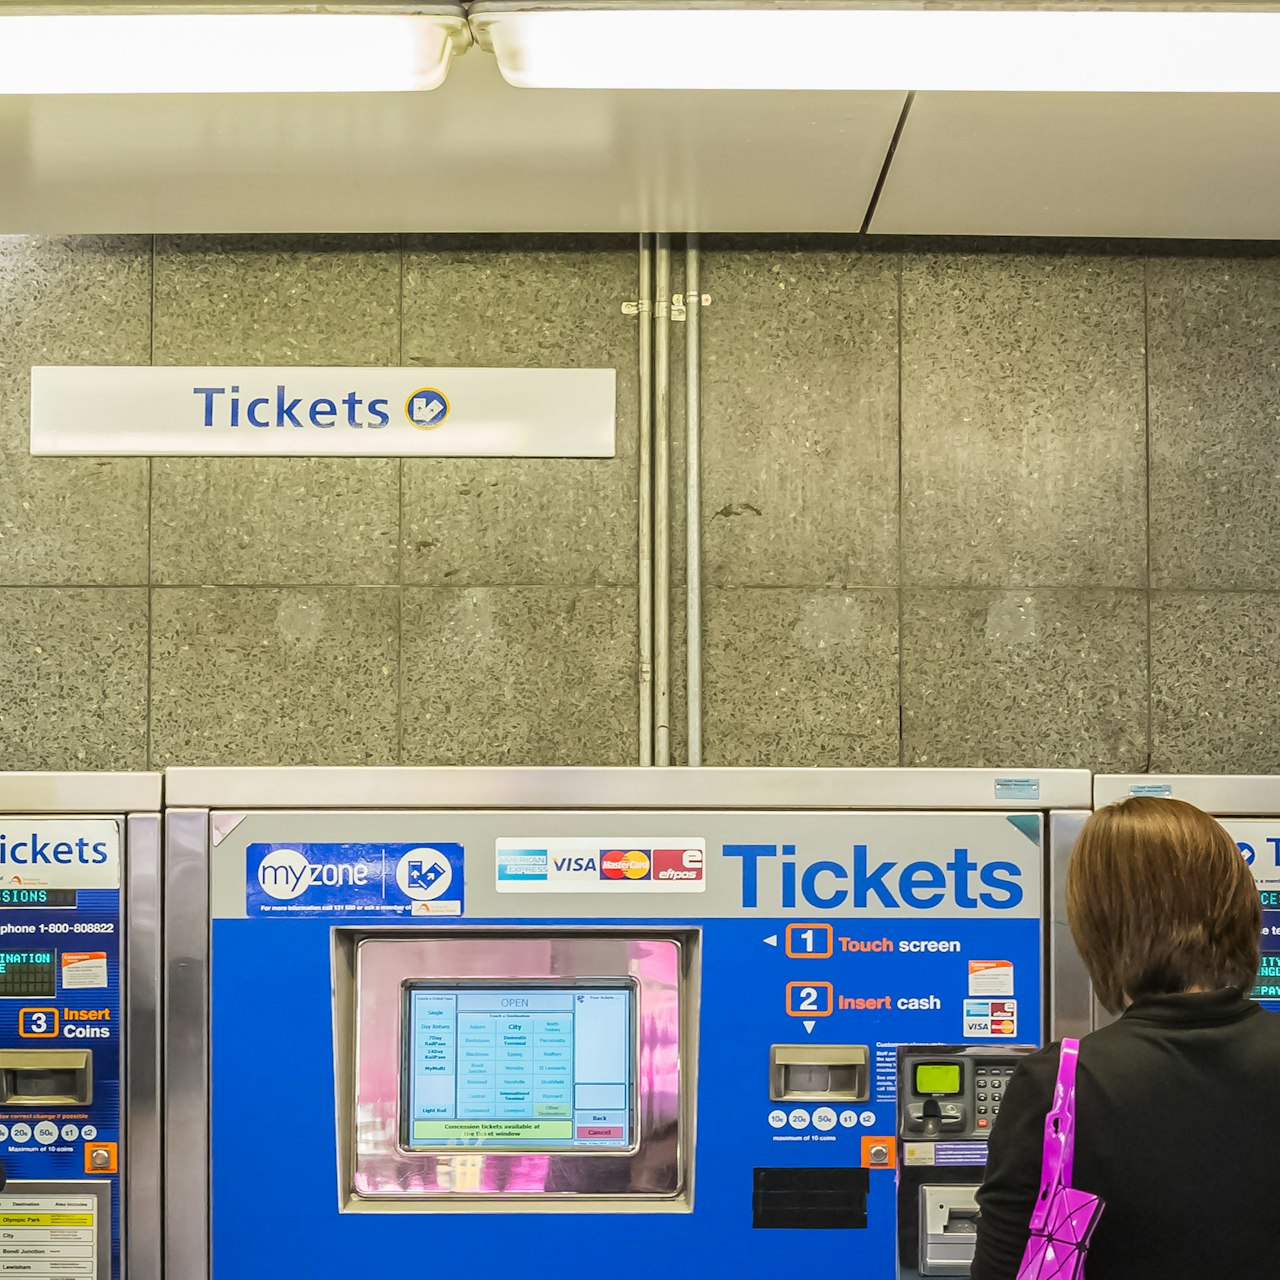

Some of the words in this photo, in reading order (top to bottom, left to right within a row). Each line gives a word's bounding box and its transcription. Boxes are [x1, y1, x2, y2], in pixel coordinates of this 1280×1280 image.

[193, 385, 390, 429] Tickets
[553, 857, 597, 872] VISA
[602, 860, 649, 870] MasterCard
[261, 863, 369, 892] myzone
[658, 867, 697, 880] eftpos
[722, 844, 1024, 910] Tickets
[39, 923, 114, 934] 1-800-808822
[800, 929, 814, 953] 1
[838, 937, 894, 953] Touch
[898, 938, 961, 953] screen
[500, 998, 529, 1008] OPEN
[799, 987, 818, 1011] 2
[838, 995, 892, 1010] Insert
[896, 994, 941, 1010] cash
[63, 1008, 111, 1021] Insert
[31, 1012, 47, 1034] 3
[508, 1023, 522, 1032] City
[967, 1023, 989, 1031] VISA
[63, 1025, 111, 1038] Coins
